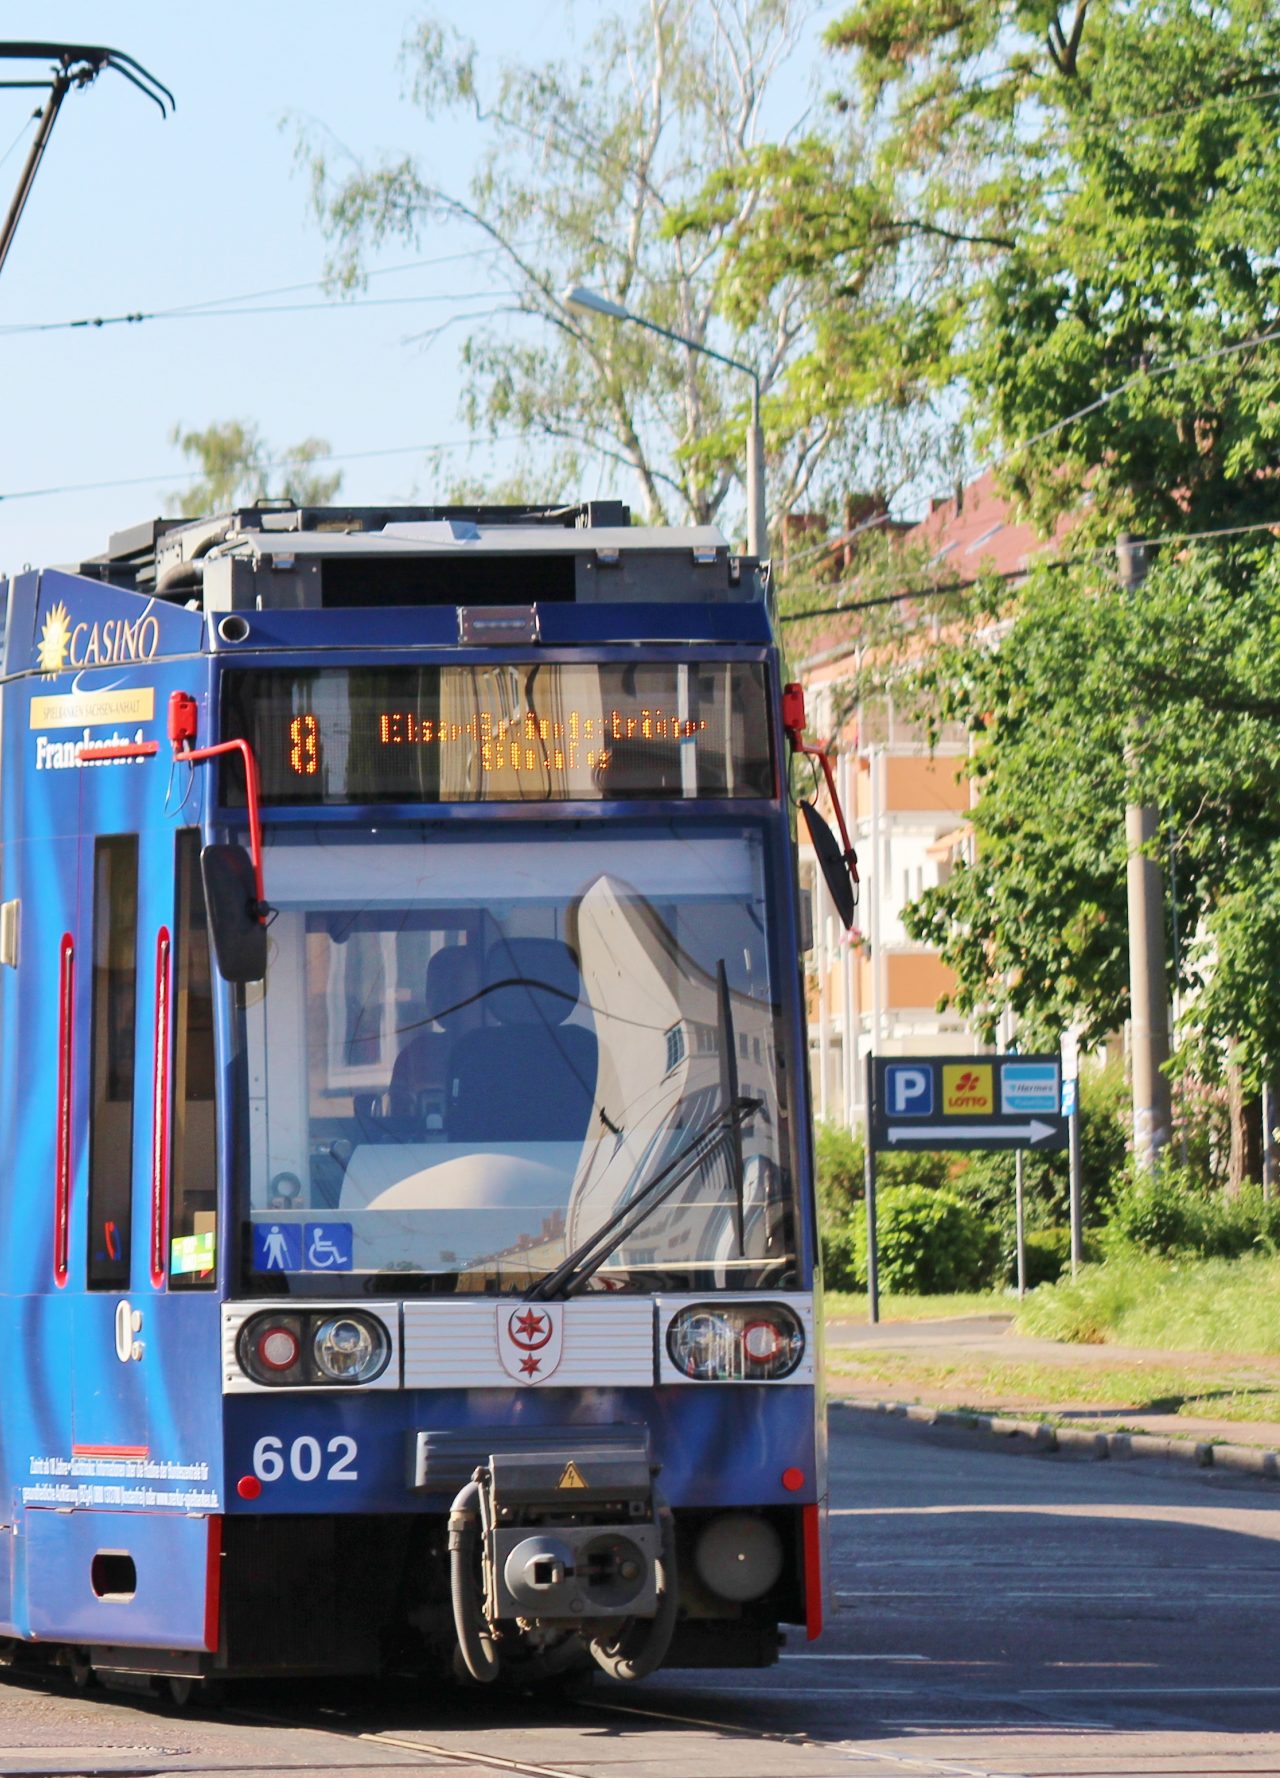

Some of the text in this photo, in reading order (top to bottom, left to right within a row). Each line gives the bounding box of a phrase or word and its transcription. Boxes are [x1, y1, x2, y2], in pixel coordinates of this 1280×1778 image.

[69, 616, 159, 667] CASINO
[289, 715, 317, 774] 8
[894, 1070, 926, 1112] P
[948, 1096, 987, 1108] LOTTO
[253, 1436, 358, 1481] 602
